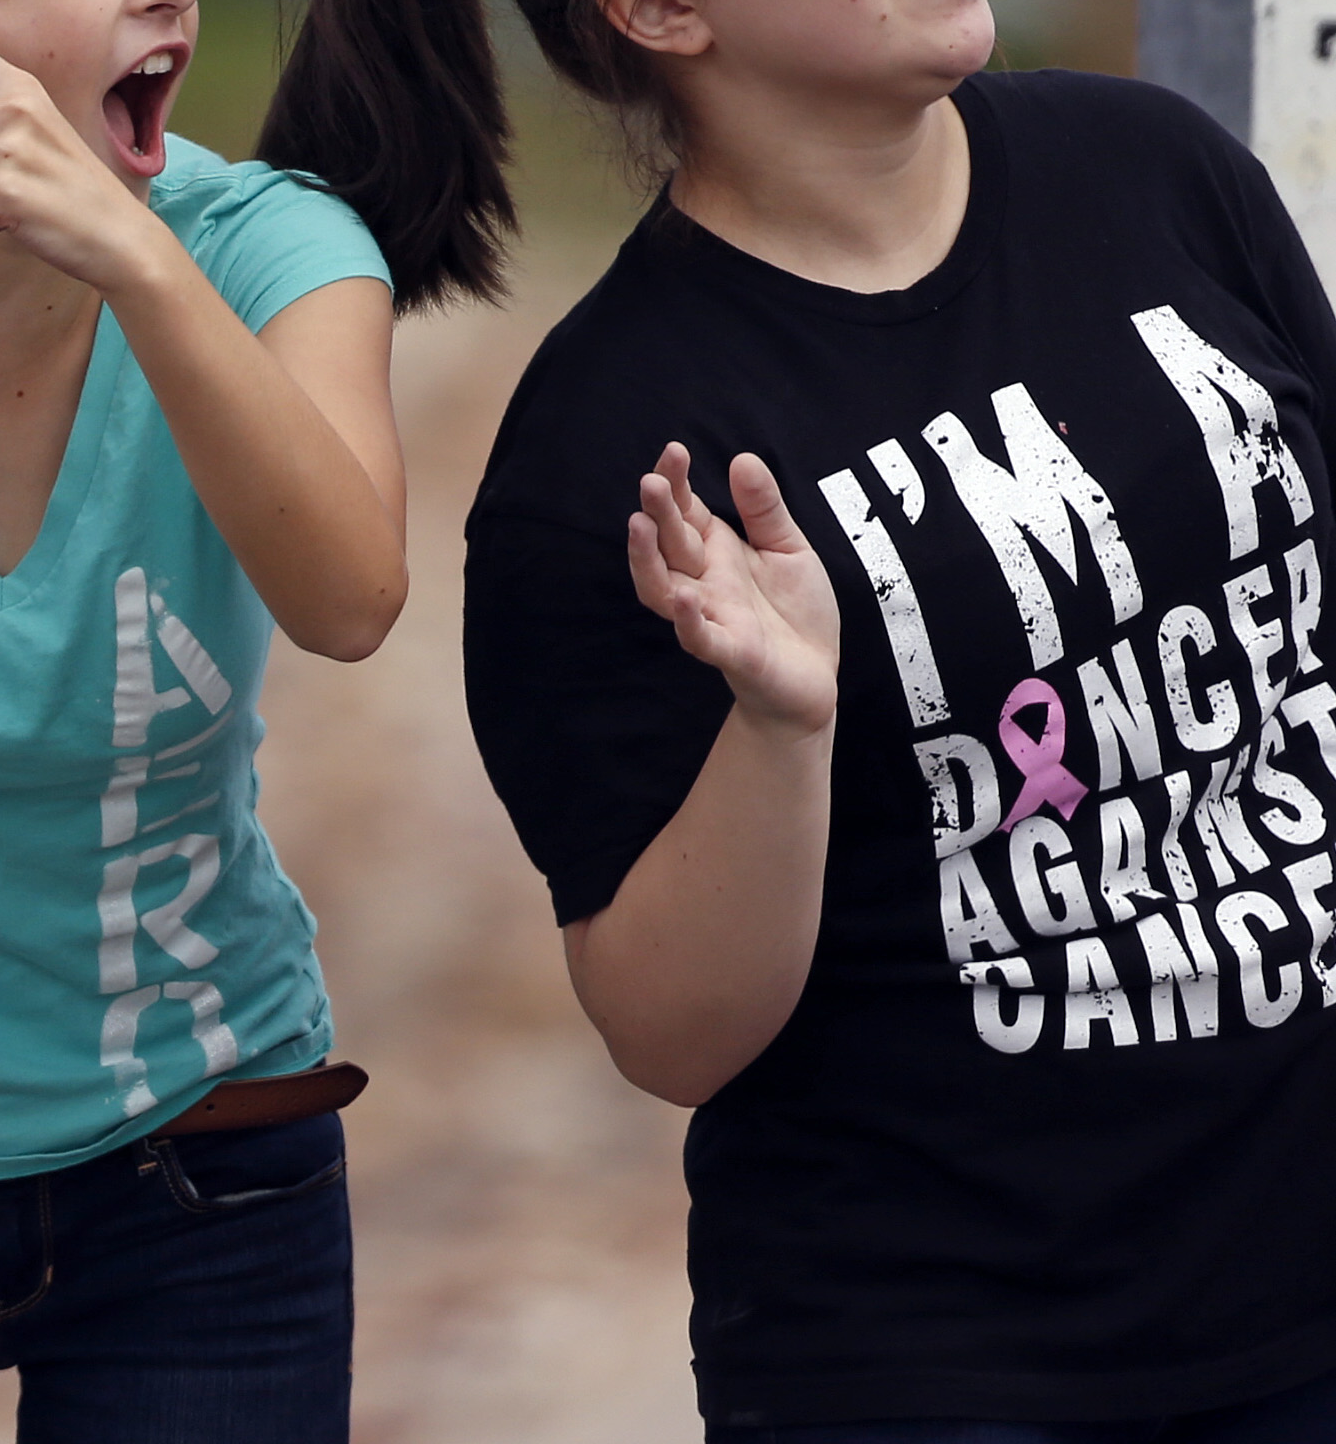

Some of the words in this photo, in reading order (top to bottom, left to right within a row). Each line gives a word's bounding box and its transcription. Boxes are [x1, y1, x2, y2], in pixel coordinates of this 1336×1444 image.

[818, 382, 1142, 726] I'M
[1130, 305, 1314, 560] A
[938, 682, 1336, 962] AGAINST
[959, 851, 1336, 1054] CANCE
